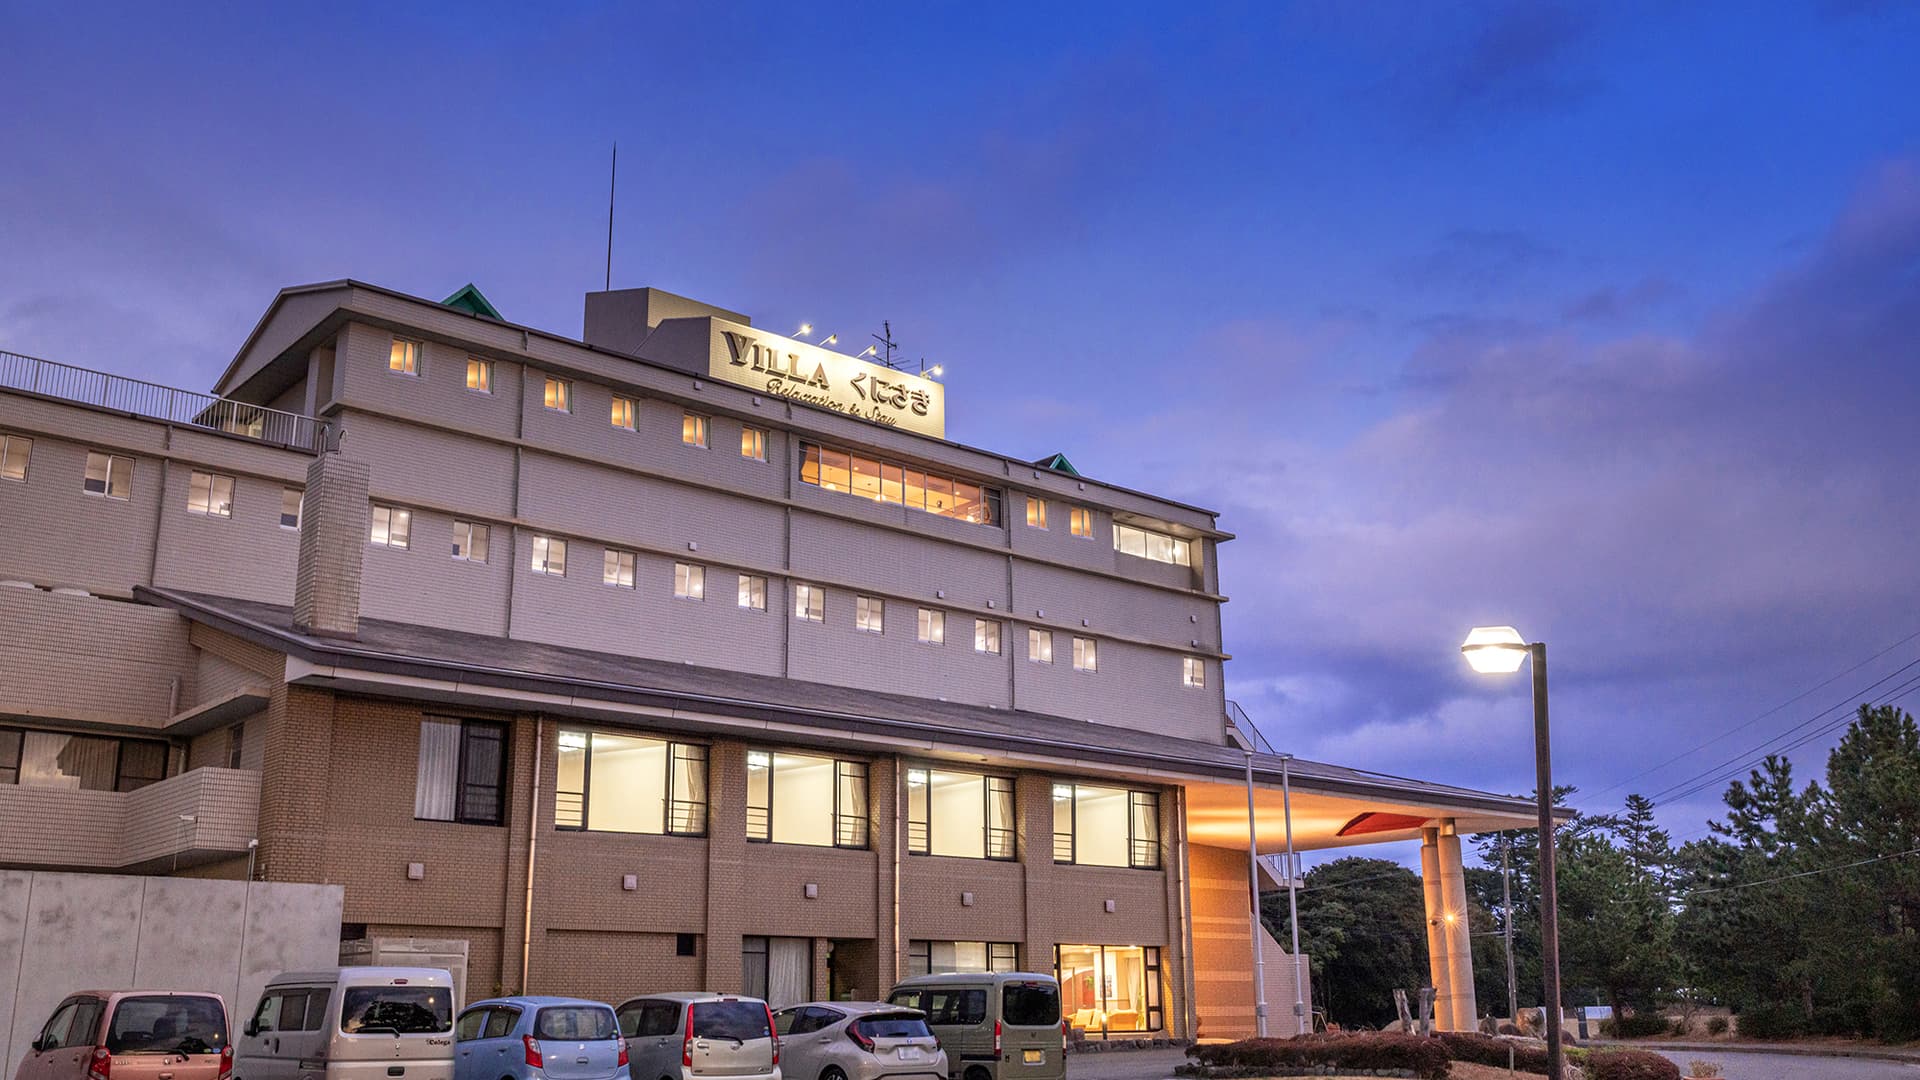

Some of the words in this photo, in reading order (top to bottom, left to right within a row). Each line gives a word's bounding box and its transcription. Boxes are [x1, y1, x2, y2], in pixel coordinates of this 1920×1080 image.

[720, 331, 830, 391] VILLA
[850, 372, 930, 416] くにさき
